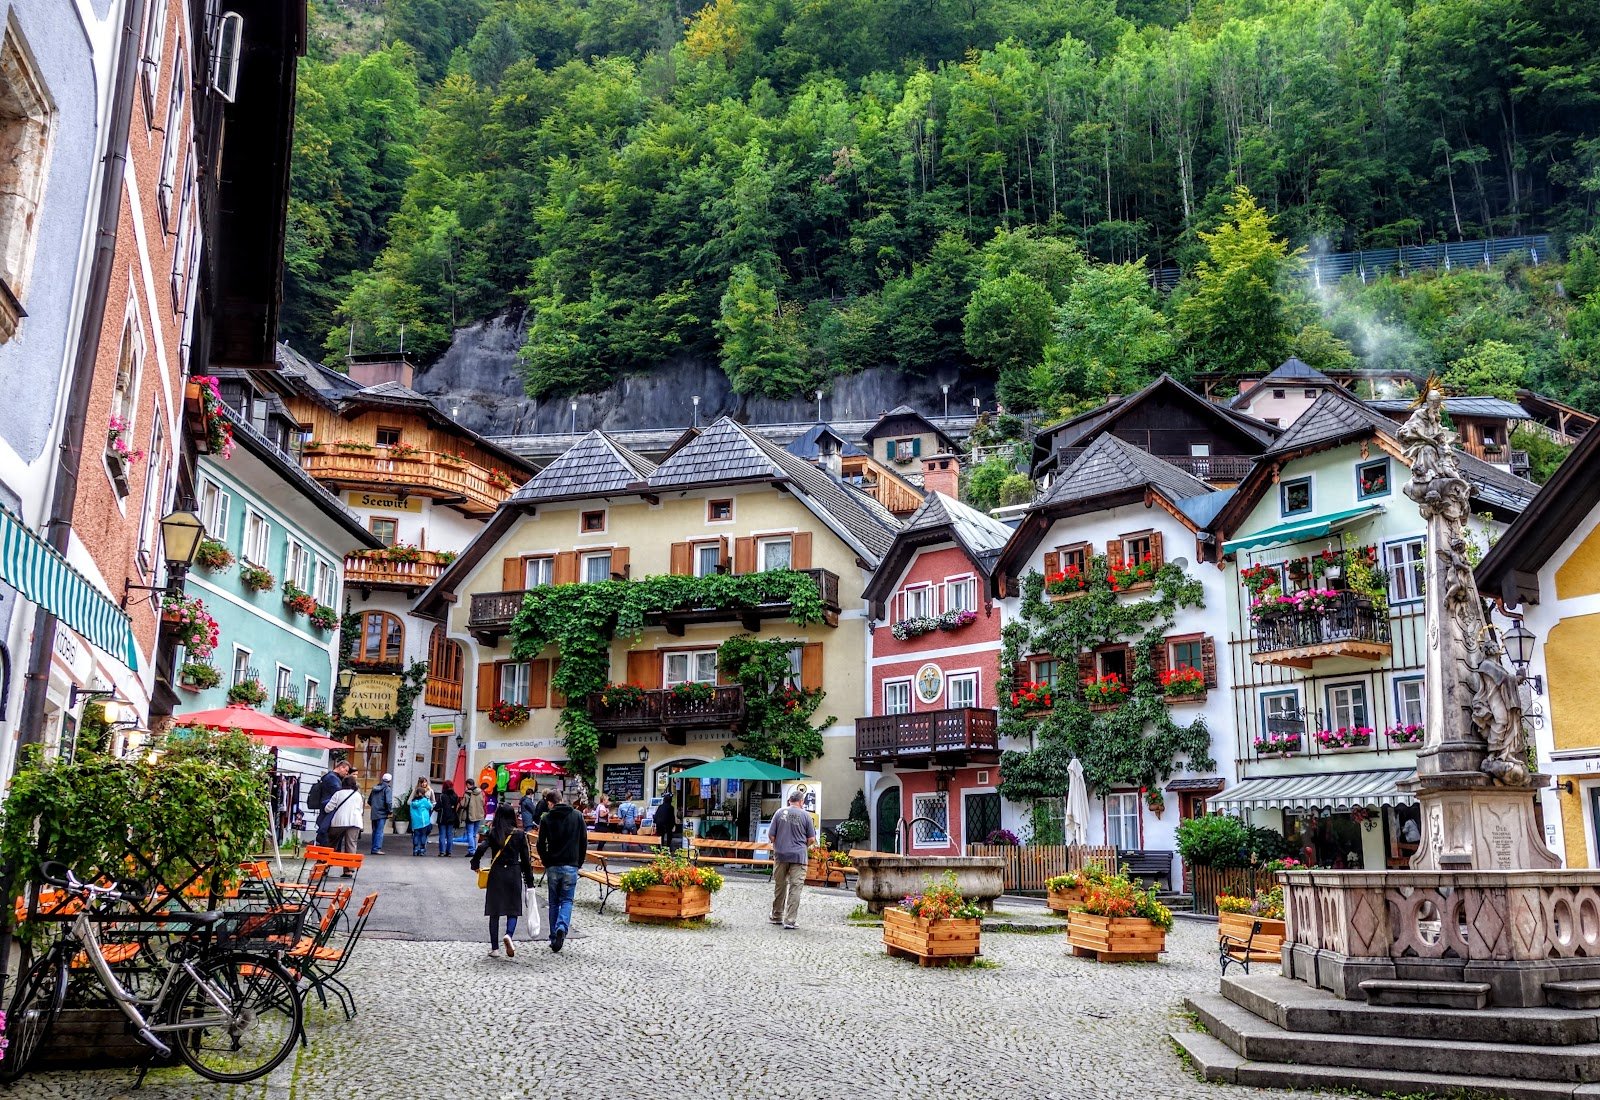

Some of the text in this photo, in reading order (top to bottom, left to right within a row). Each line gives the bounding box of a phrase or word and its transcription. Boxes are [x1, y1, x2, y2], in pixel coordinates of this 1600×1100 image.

[362, 494, 408, 509] Seewirt
[351, 691, 393, 701] GASTHOF
[351, 701, 390, 711] ZAUNER
